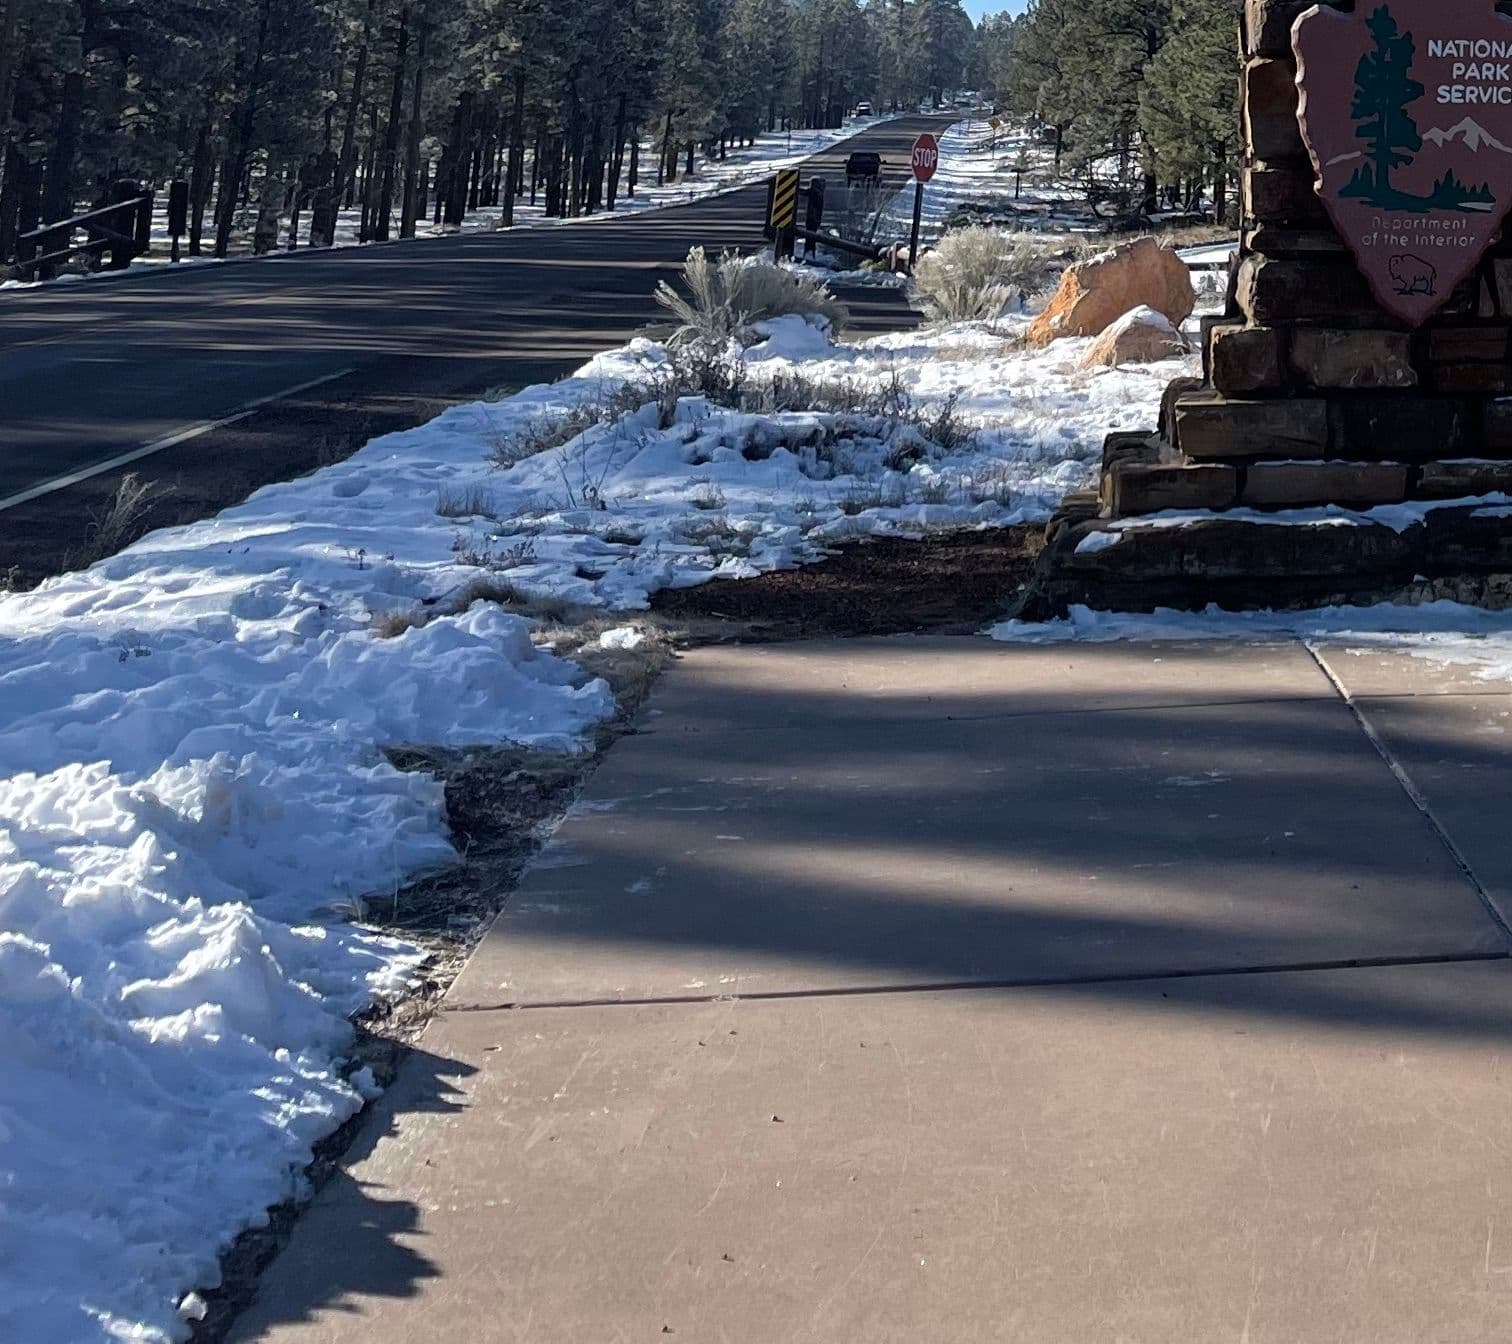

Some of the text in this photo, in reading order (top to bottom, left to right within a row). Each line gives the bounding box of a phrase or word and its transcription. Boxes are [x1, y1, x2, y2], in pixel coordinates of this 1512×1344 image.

[1452, 62, 1511, 81] PARK
[913, 147, 937, 168] STOP
[1361, 232, 1378, 246] of
[1384, 232, 1409, 246] the
